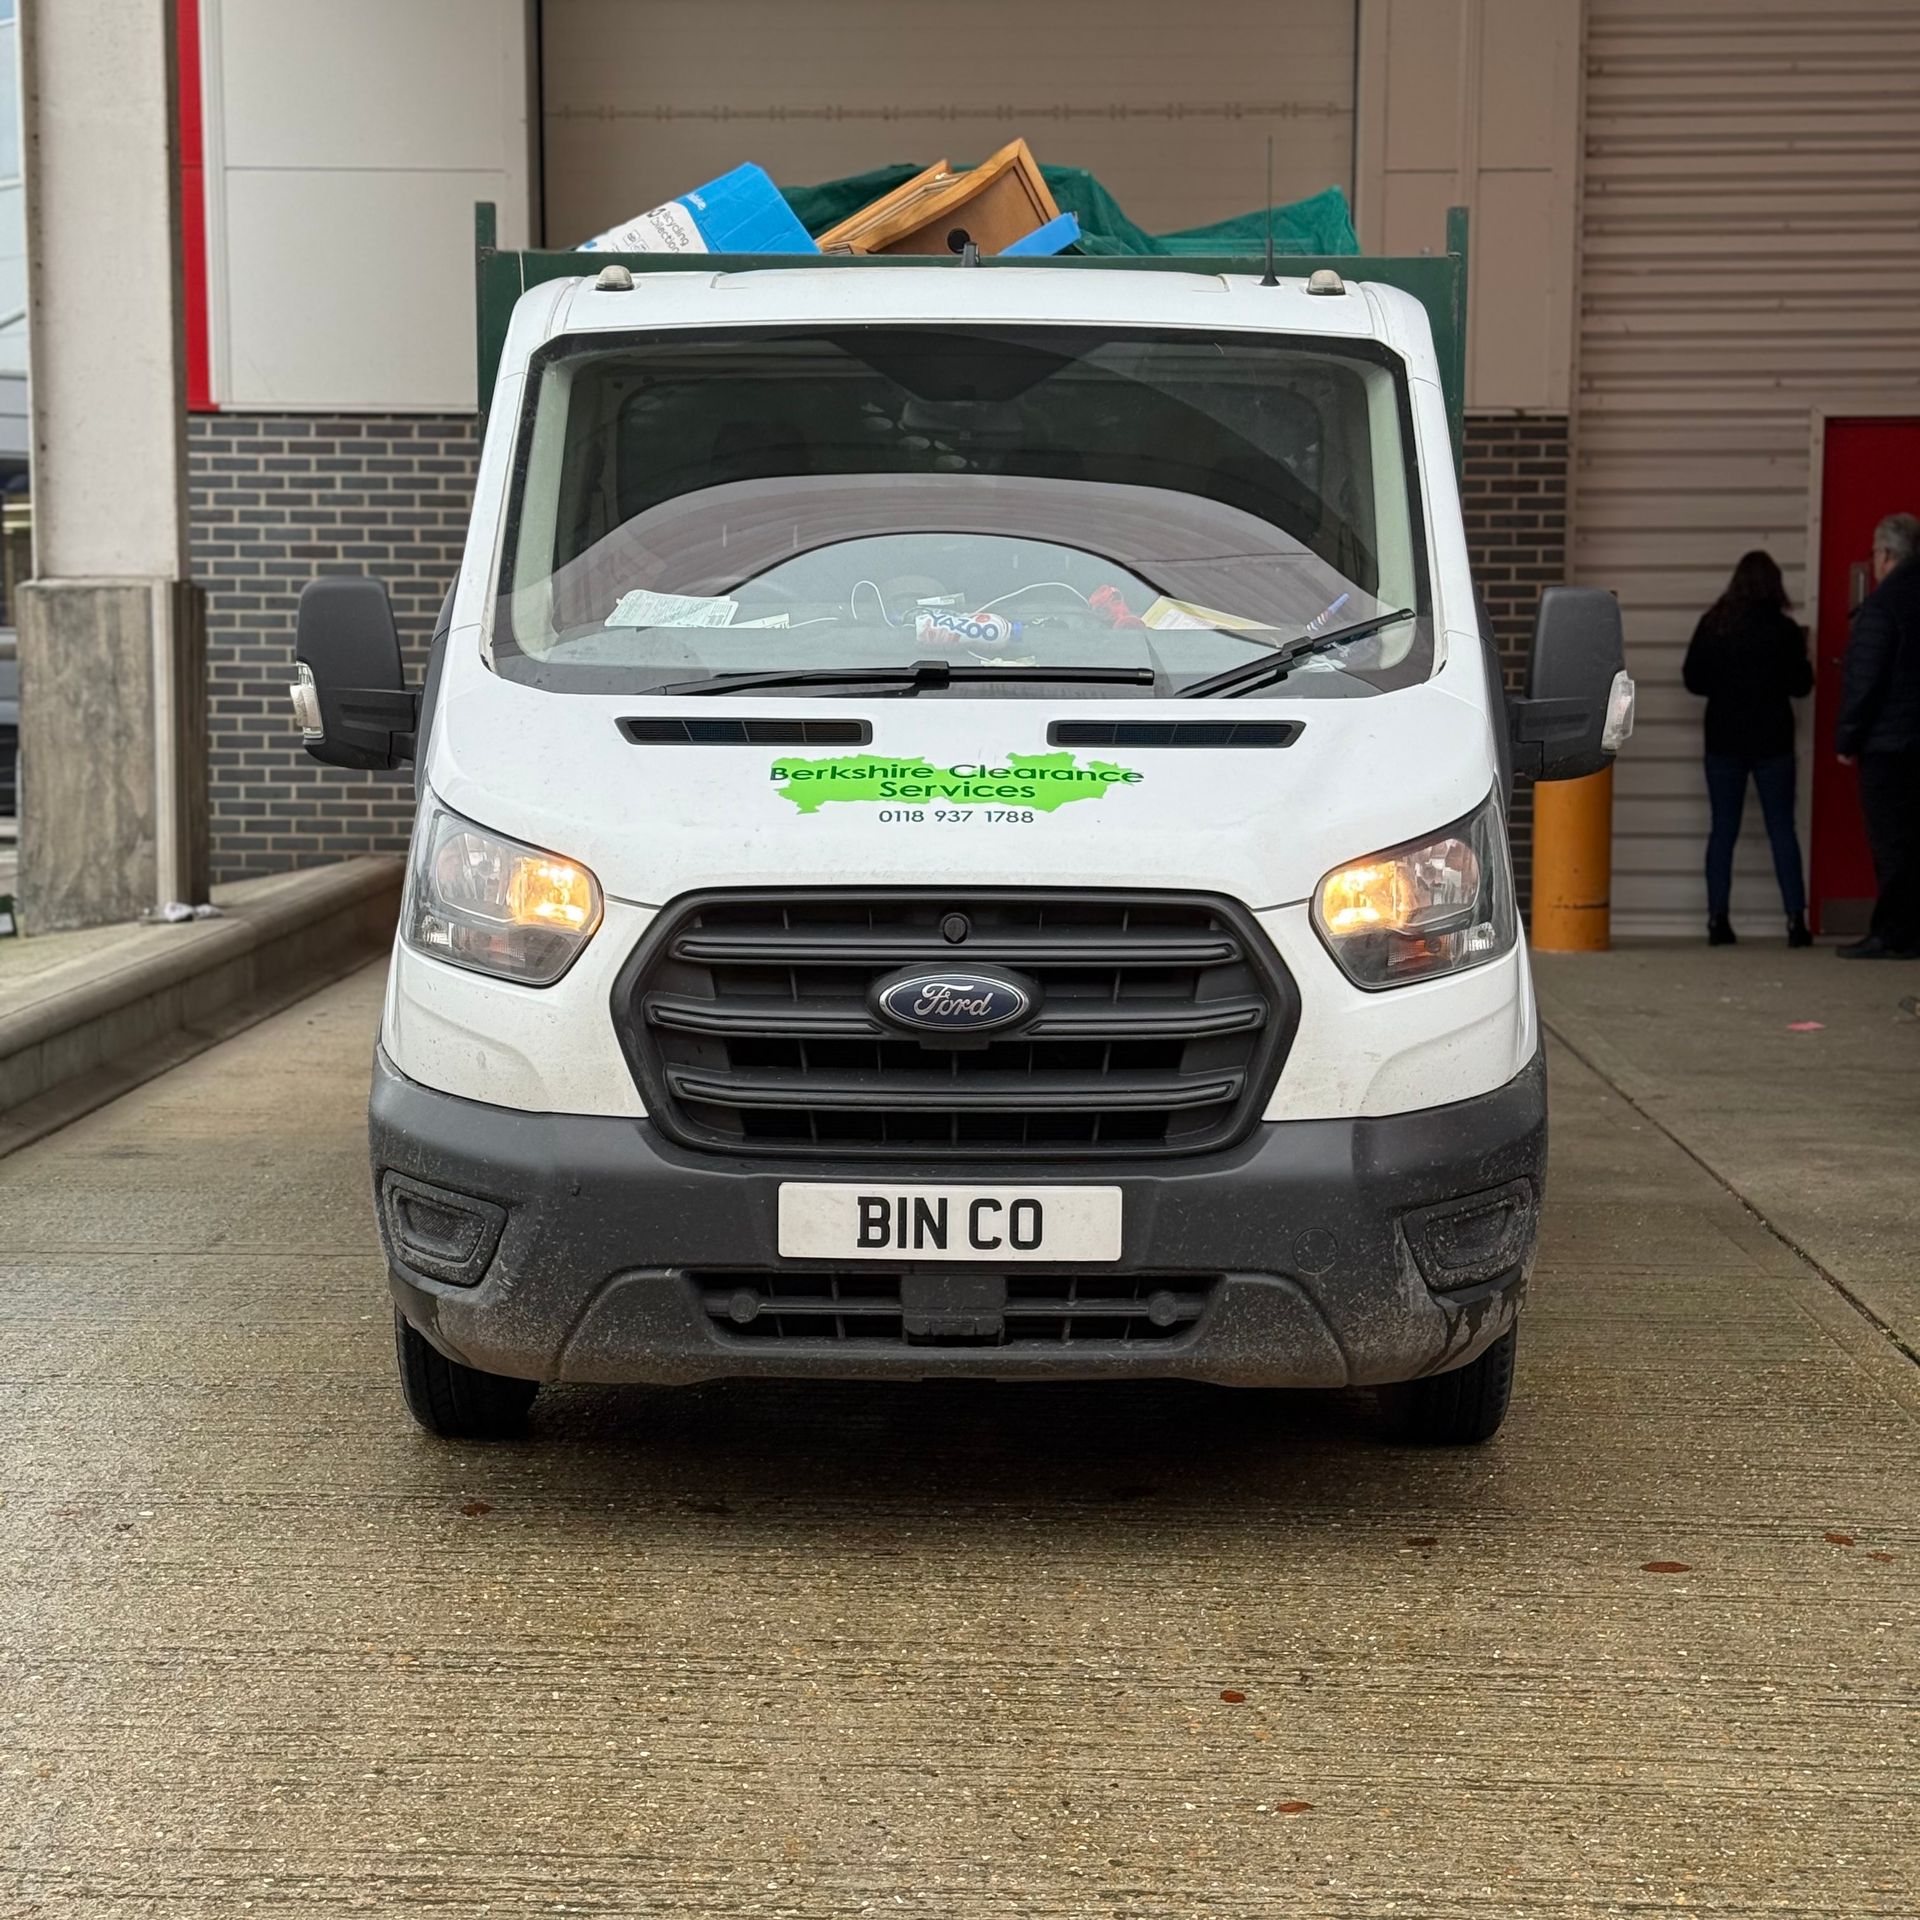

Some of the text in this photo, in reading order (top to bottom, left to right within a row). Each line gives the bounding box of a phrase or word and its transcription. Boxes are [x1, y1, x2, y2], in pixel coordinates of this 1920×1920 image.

[929, 610, 1000, 642] YAZOO
[769, 763, 1145, 783] Berkshire Clearance
[879, 780, 1036, 799] Services
[878, 810, 1035, 824] 0118 937 1788
[913, 982, 995, 1017] Ford
